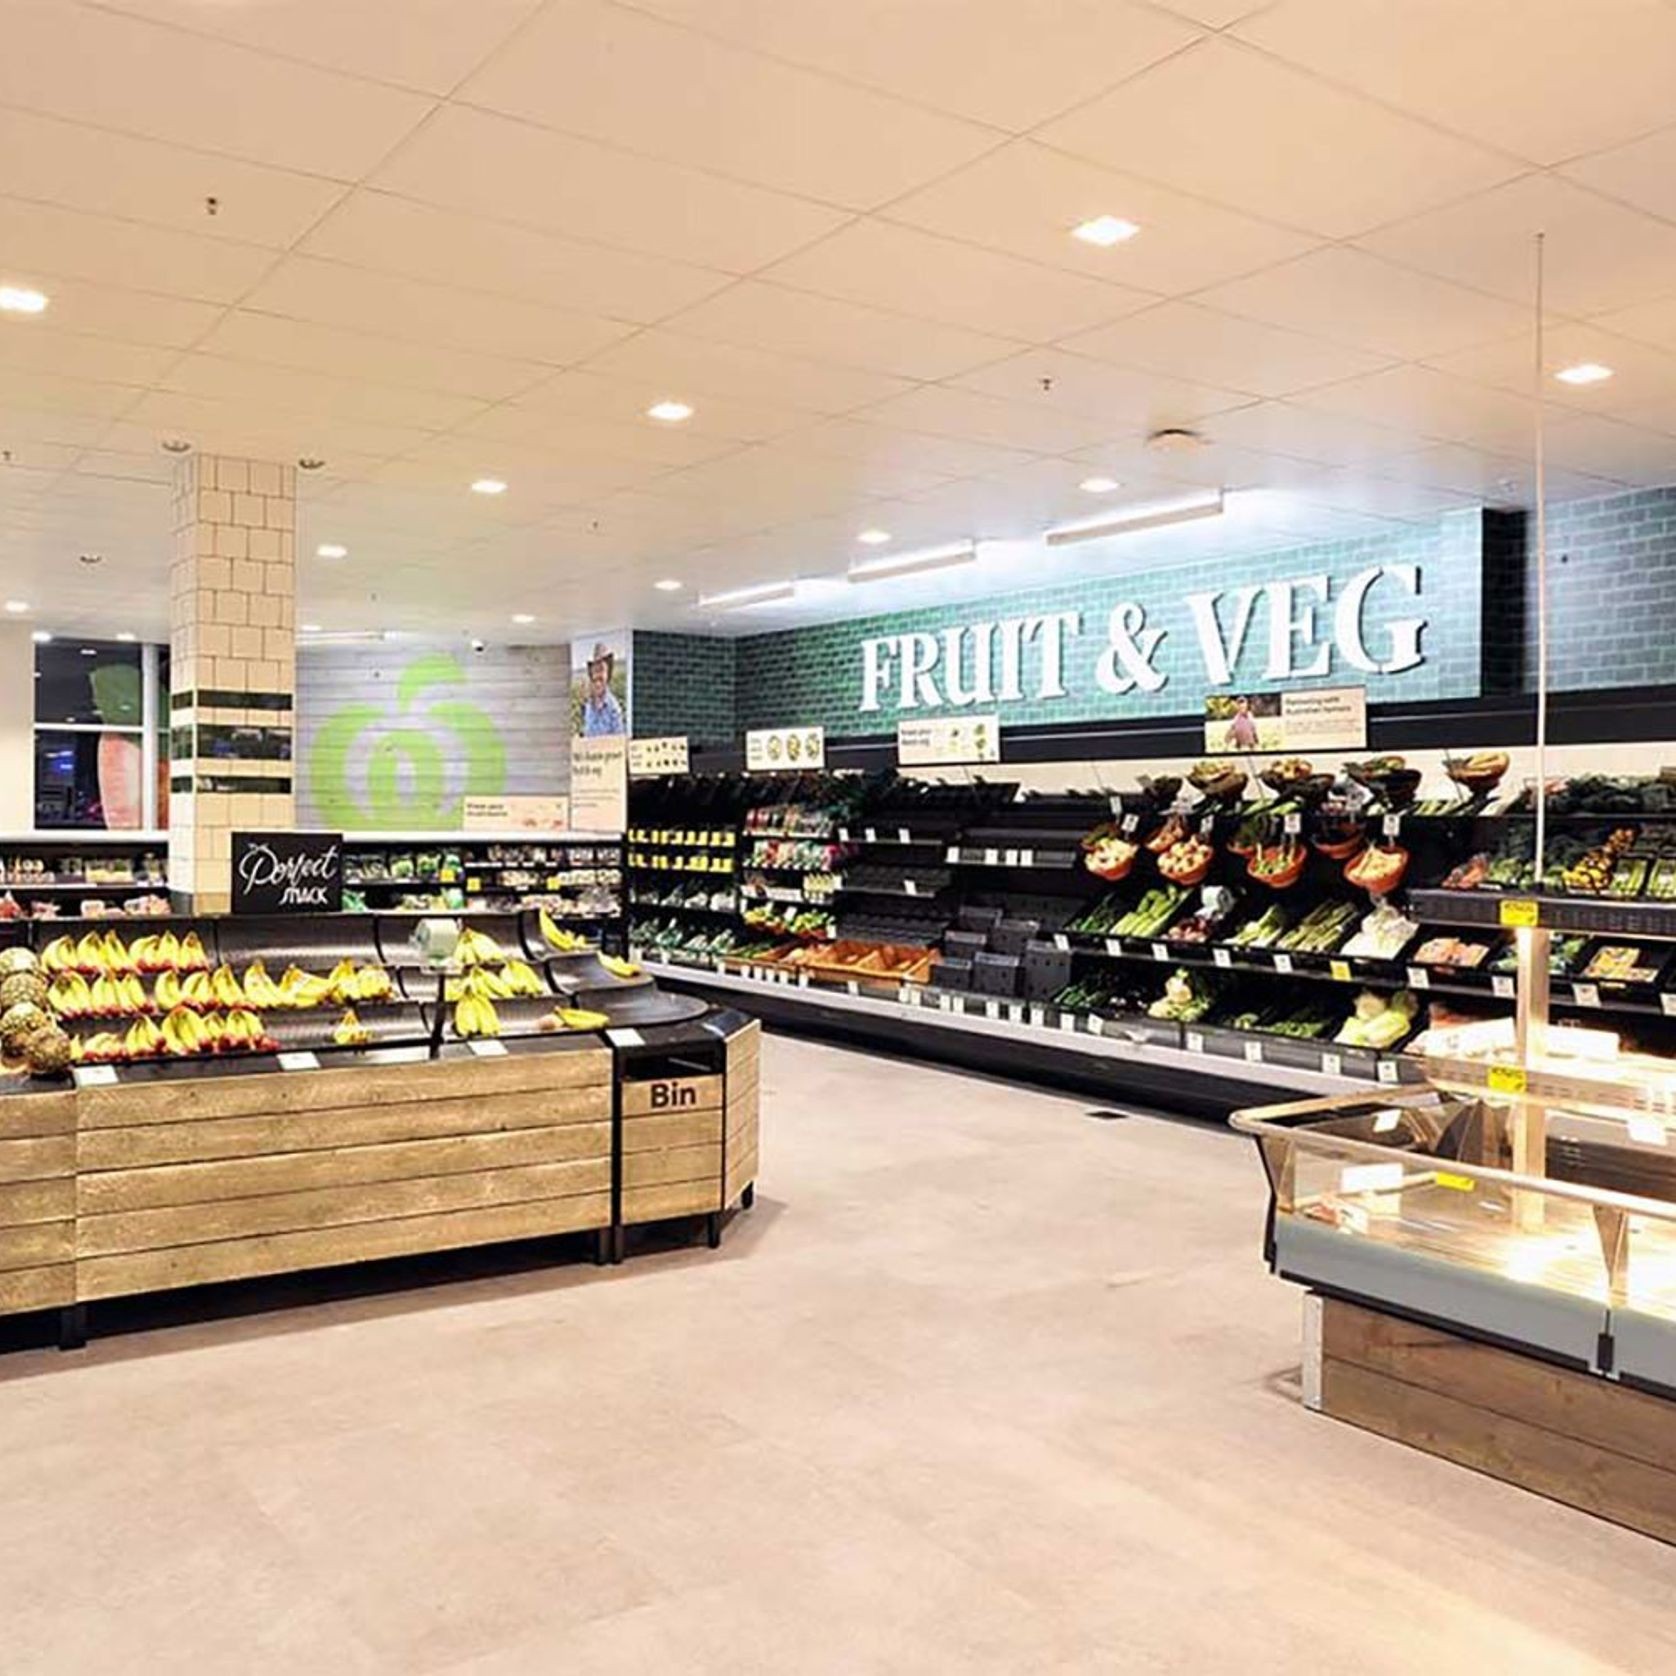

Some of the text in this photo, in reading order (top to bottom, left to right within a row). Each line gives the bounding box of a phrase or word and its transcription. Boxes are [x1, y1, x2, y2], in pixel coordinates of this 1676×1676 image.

[858, 564, 1428, 712] FRUIT & VEG
[650, 1080, 697, 1110] Bin
